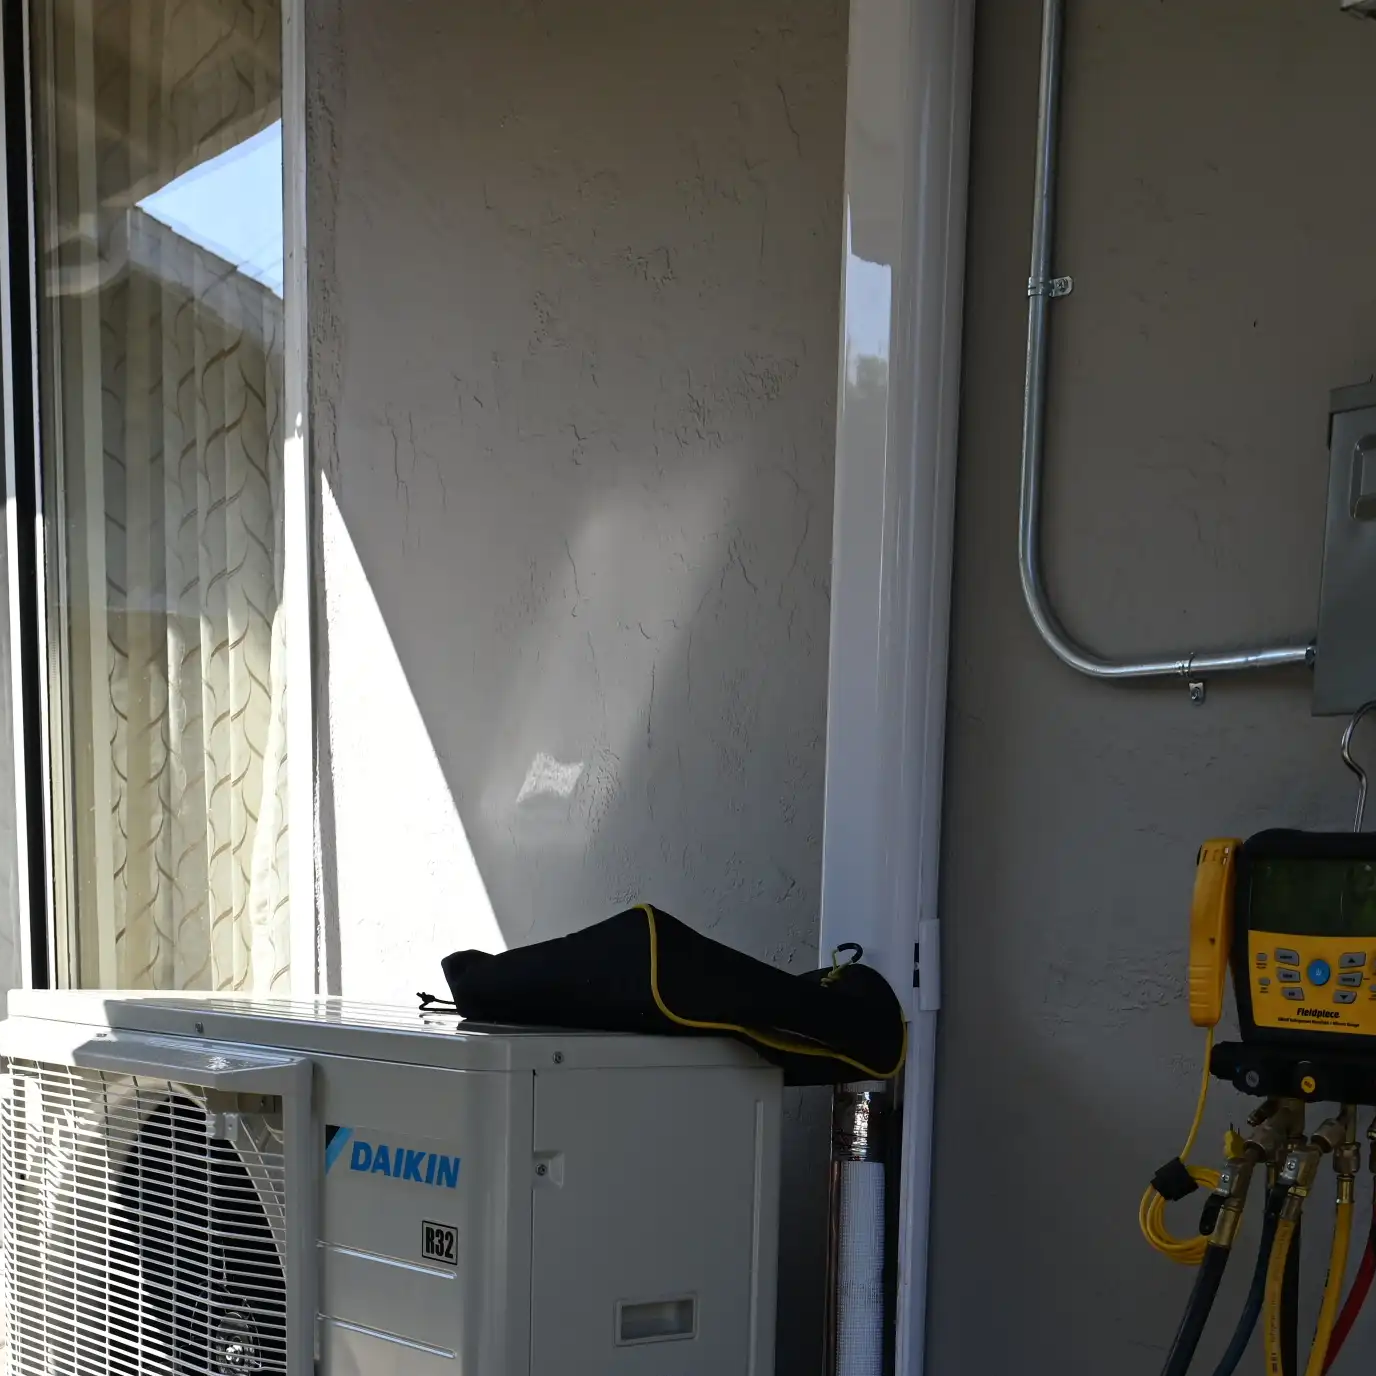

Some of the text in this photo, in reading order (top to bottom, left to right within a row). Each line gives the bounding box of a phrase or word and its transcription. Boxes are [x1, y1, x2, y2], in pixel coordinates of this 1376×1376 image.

[1296, 1007, 1340, 1019] Fieldpiece
[350, 1140, 461, 1188] DAIKIN
[425, 1226, 454, 1259] R32
